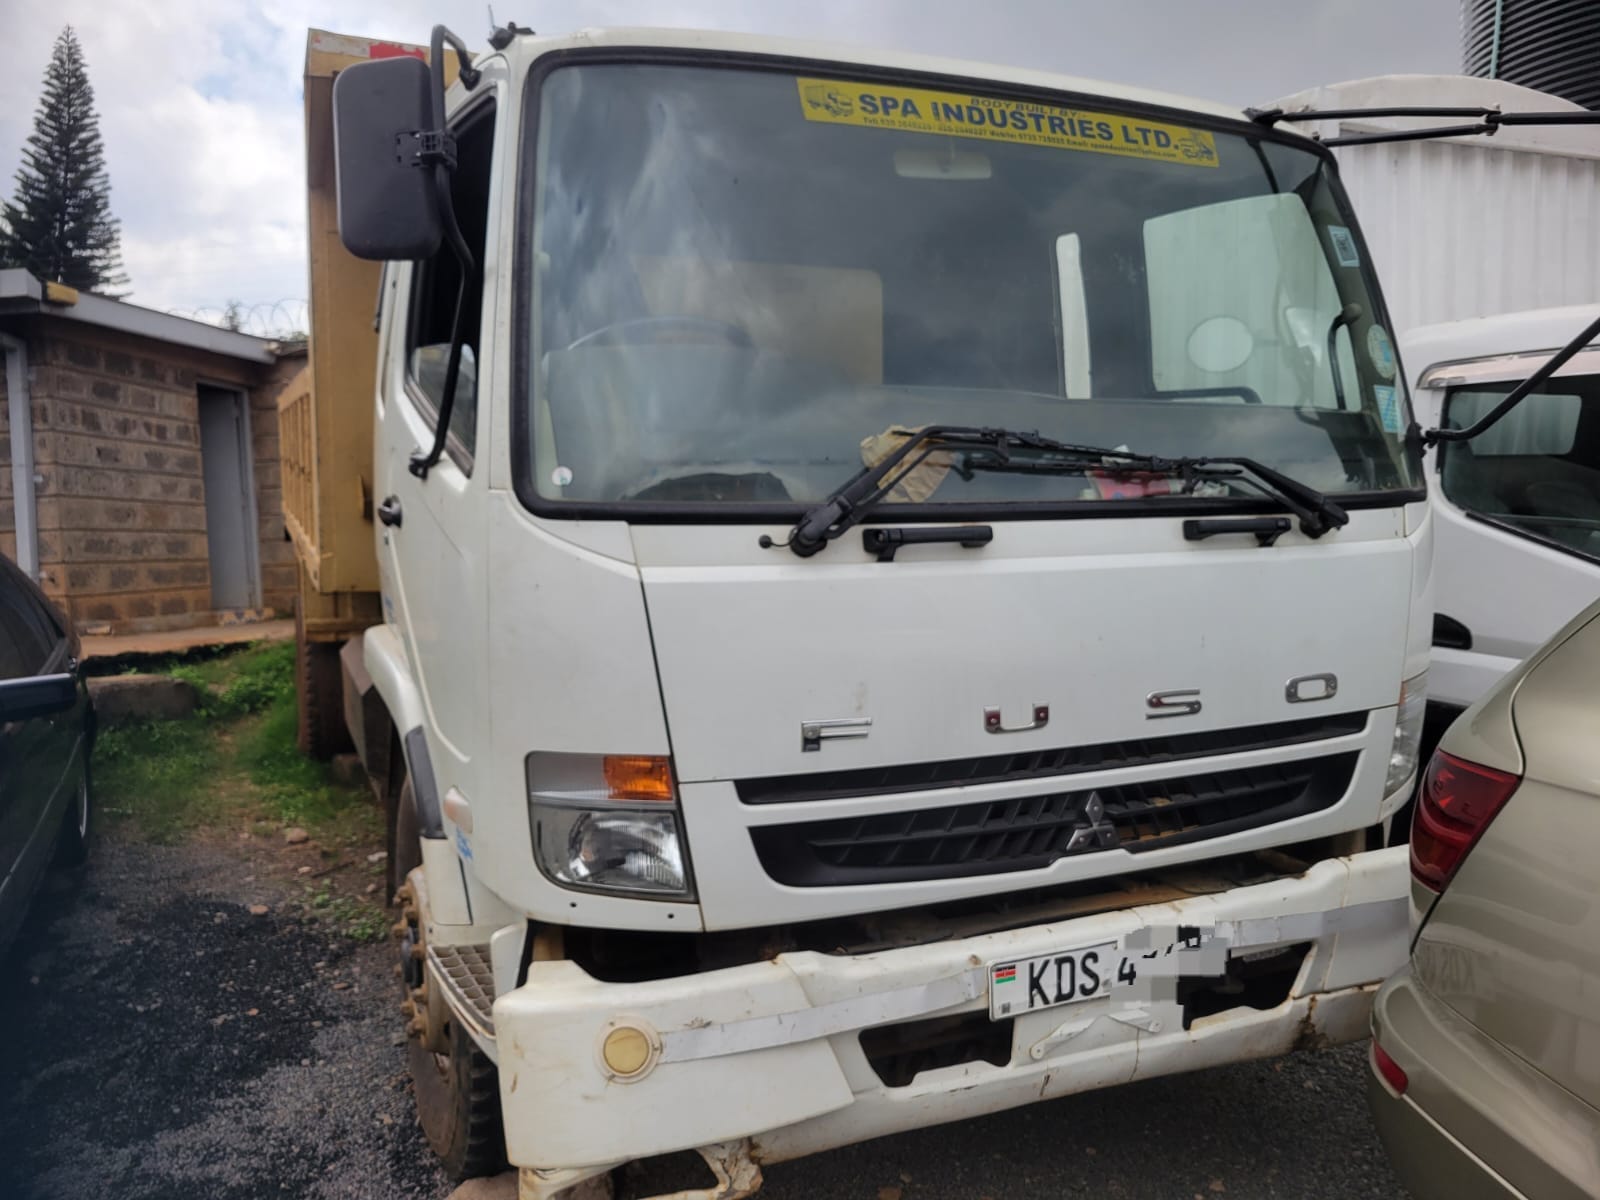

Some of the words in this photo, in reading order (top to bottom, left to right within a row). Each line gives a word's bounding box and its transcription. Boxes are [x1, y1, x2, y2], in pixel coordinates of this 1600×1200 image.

[858, 94, 922, 119] SPA
[931, 102, 1113, 141] INDUSTRIES
[1121, 125, 1179, 150] LTD.
[971, 97, 1011, 109] BODY
[802, 673, 1338, 752] FUSO
[1028, 951, 1100, 1008] KDS
